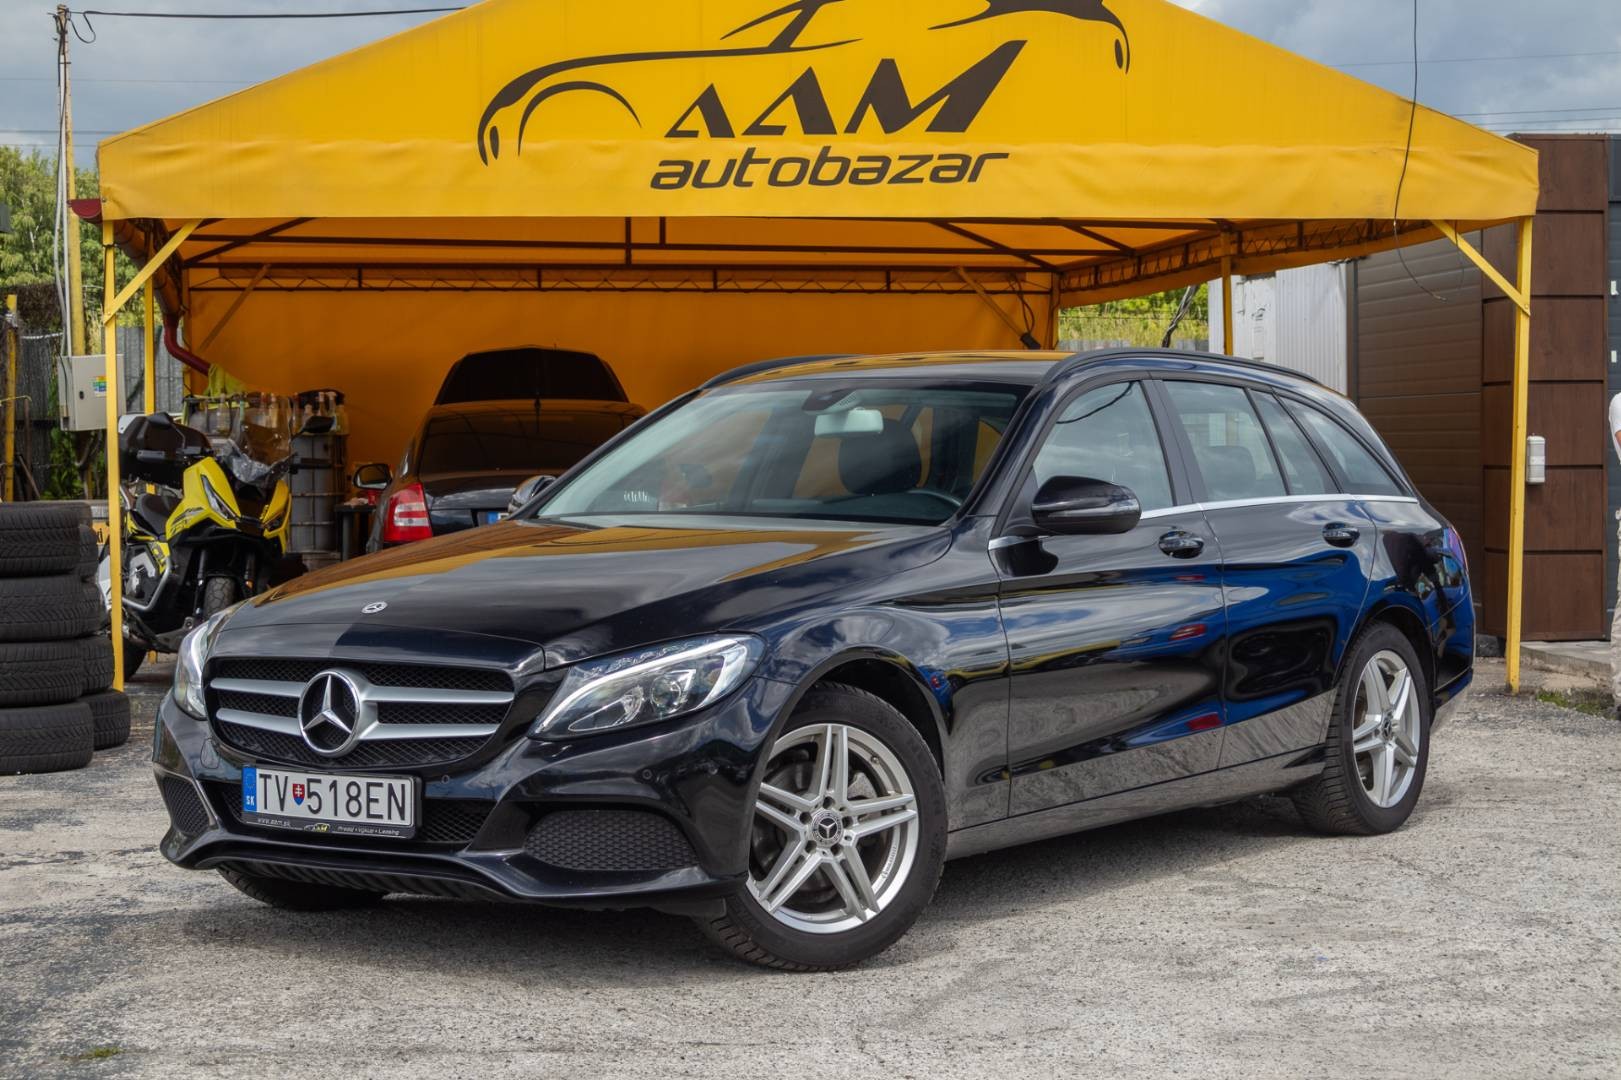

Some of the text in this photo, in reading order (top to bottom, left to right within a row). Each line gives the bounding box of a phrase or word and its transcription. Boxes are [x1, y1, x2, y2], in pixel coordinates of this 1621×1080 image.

[664, 39, 1027, 138] AAM
[650, 146, 1009, 190] autobazar
[245, 795, 255, 806] SK
